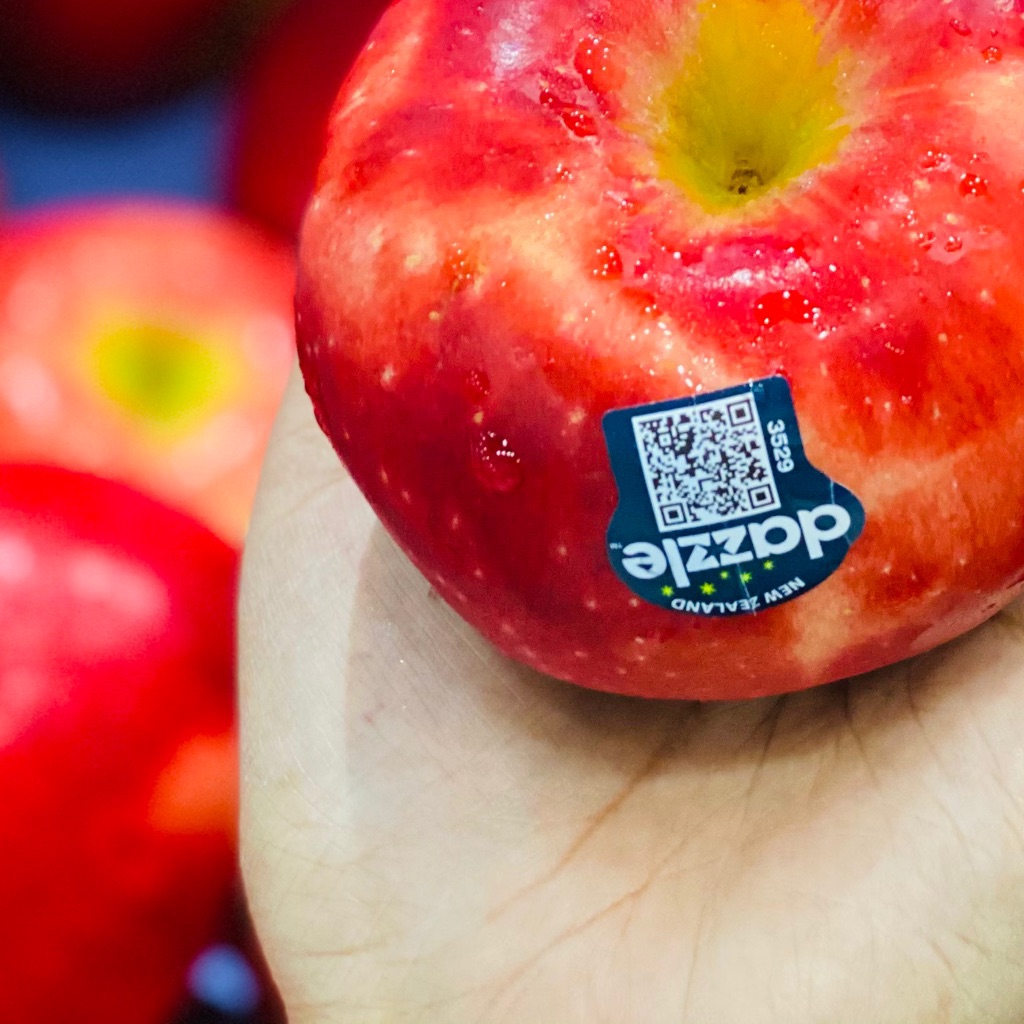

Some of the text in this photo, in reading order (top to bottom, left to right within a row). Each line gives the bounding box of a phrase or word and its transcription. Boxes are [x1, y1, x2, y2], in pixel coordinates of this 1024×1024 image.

[766, 418, 795, 474] 3529
[621, 503, 851, 589] dazzle
[670, 576, 806, 615] NEW ZEALAND
